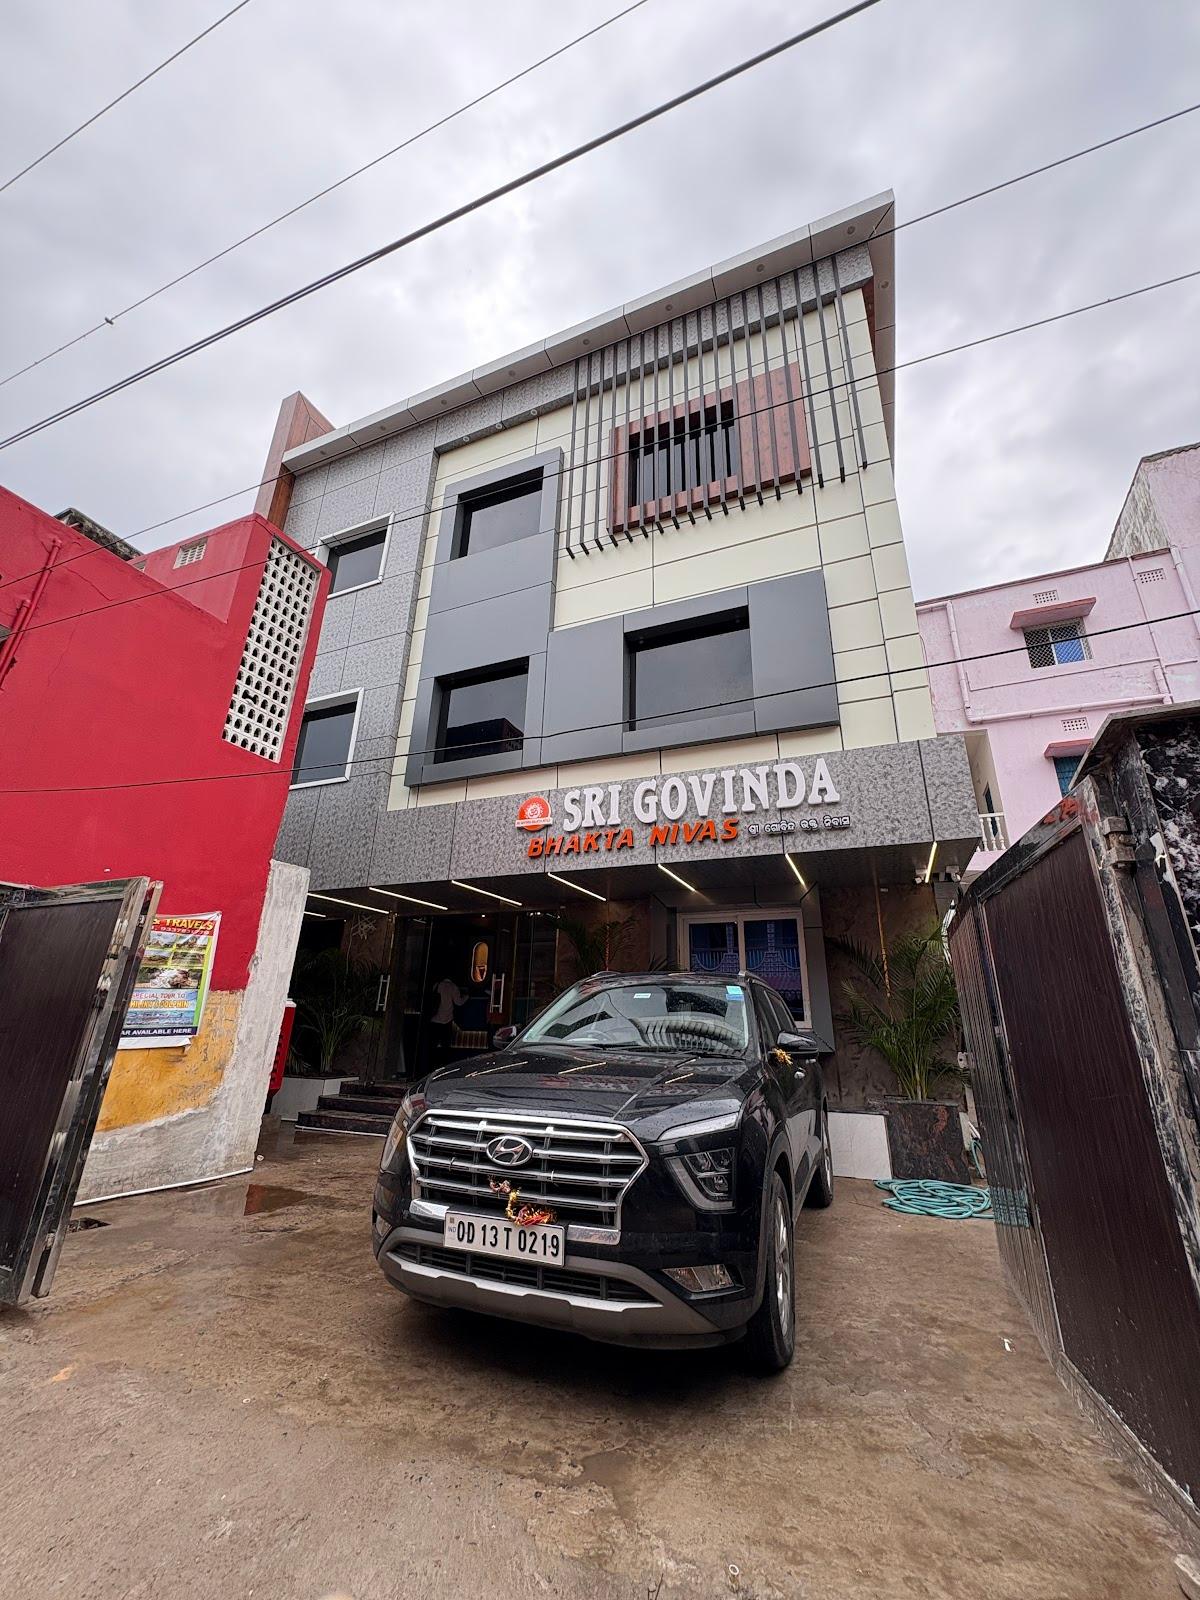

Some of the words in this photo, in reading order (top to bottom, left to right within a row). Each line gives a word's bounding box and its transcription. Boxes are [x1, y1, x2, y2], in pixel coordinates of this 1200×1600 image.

[563, 784, 623, 832] SRI
[633, 757, 841, 824] GOVINDA
[527, 828, 635, 858] BHAKTA
[650, 818, 740, 846] NIVAS
[166, 919, 214, 931] TRAVELS
[132, 1028, 172, 1036] AVAILABLE
[481, 1224, 498, 1247] 13
[504, 1228, 512, 1250] T
[518, 1229, 560, 1257] 0219
